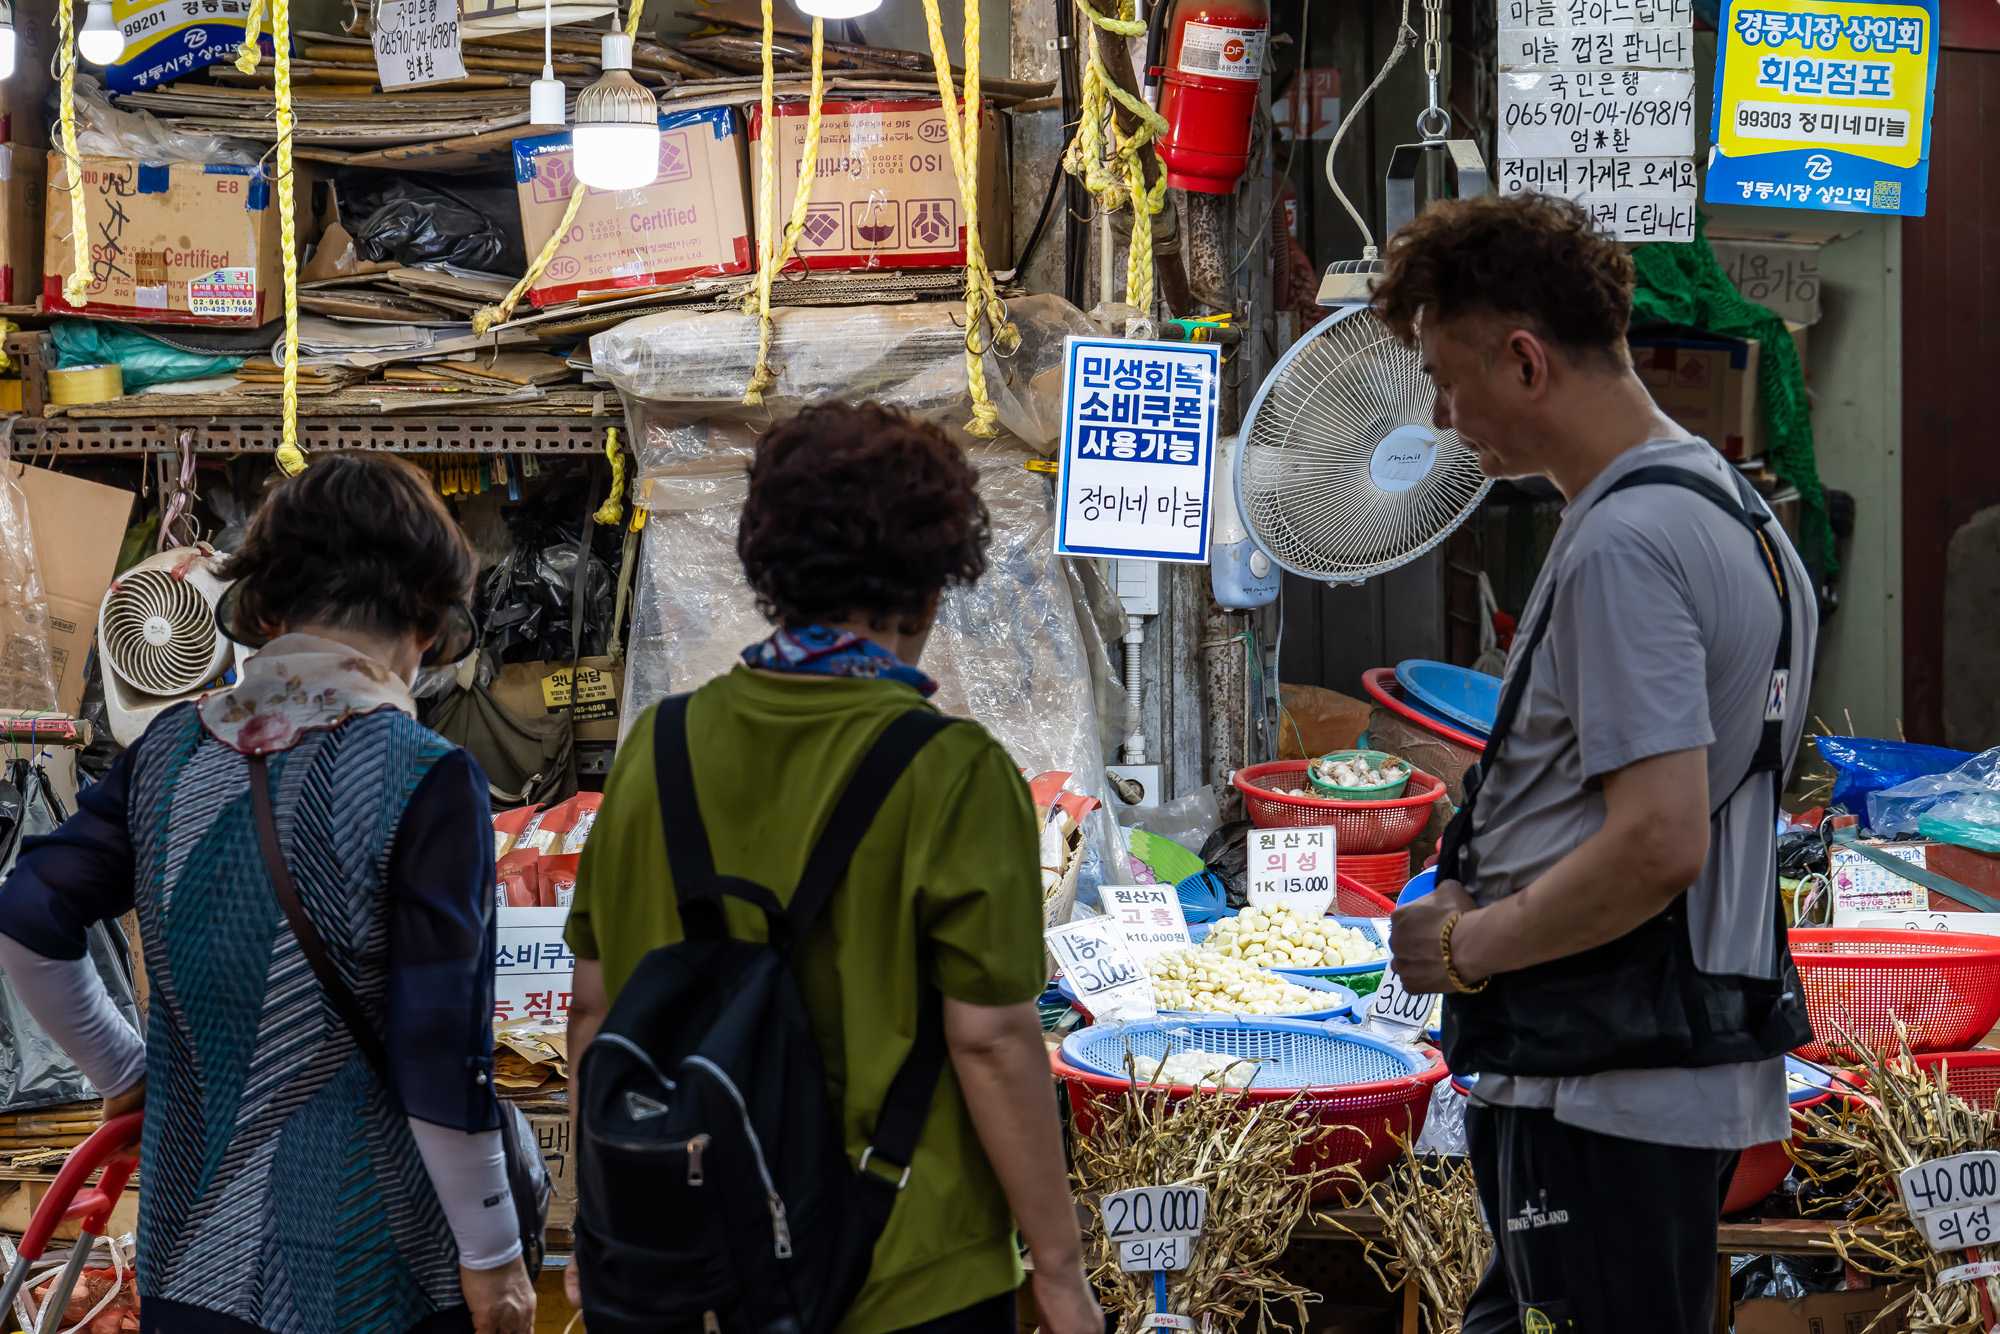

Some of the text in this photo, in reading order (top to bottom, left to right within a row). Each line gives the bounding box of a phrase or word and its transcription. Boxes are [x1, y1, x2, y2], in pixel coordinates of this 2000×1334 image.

[124, 10, 166, 37] 99201
[400, 0, 437, 28] 국민은행
[1510, 0, 1557, 26] 마늘
[379, 20, 458, 55] 065901-04-169819
[1738, 12, 1921, 52] 경동시장 상인회
[1522, 31, 1687, 64] 마늘 껍질 팝니다
[133, 51, 195, 86] 경동시장
[1759, 57, 1891, 96] 회원점포
[1549, 71, 1639, 100] 국민은행
[895, 120, 911, 128] SIG
[1505, 100, 1692, 126] 065901-04-169819
[1738, 109, 1905, 138] 99303 정미네마늘
[924, 124, 949, 138] SIG
[795, 154, 942, 178] ISO Certifid
[1504, 158, 1696, 194] 정미네 가게로 오세요
[216, 180, 239, 194] E8
[1736, 180, 1812, 202] 경동시장
[1816, 186, 1871, 206] 상인회
[630, 205, 697, 233] Certified
[1624, 203, 1695, 236] 드립니다
[92, 243, 230, 269] SO Certified
[551, 261, 575, 276] SIG
[588, 266, 604, 276] SIG
[657, 254, 685, 266] Korea
[687, 250, 705, 262] Ltd.
[233, 271, 249, 283] 퀵
[1727, 253, 1819, 303] 사용가능
[114, 289, 129, 298] SIG
[1083, 357, 1204, 396] 민생회복
[1079, 391, 1202, 429] 소비쿠폰
[1082, 429, 1195, 463] 사용가능
[1079, 485, 1202, 529] 정미네 마늘
[1267, 852, 1316, 873] 의성
[1115, 890, 1167, 904] 원산지
[1255, 876, 1328, 892] 1K 15.000
[1839, 897, 1913, 908] 010-8708-5112
[1121, 908, 1173, 926] 고흥
[1910, 1159, 1996, 1208] 40.000
[1108, 1190, 1199, 1237] 20.000
[1533, 1209, 1569, 1228] ISLAND
[1938, 1206, 1991, 1244] 의성
[1127, 1238, 1176, 1269] 의성
